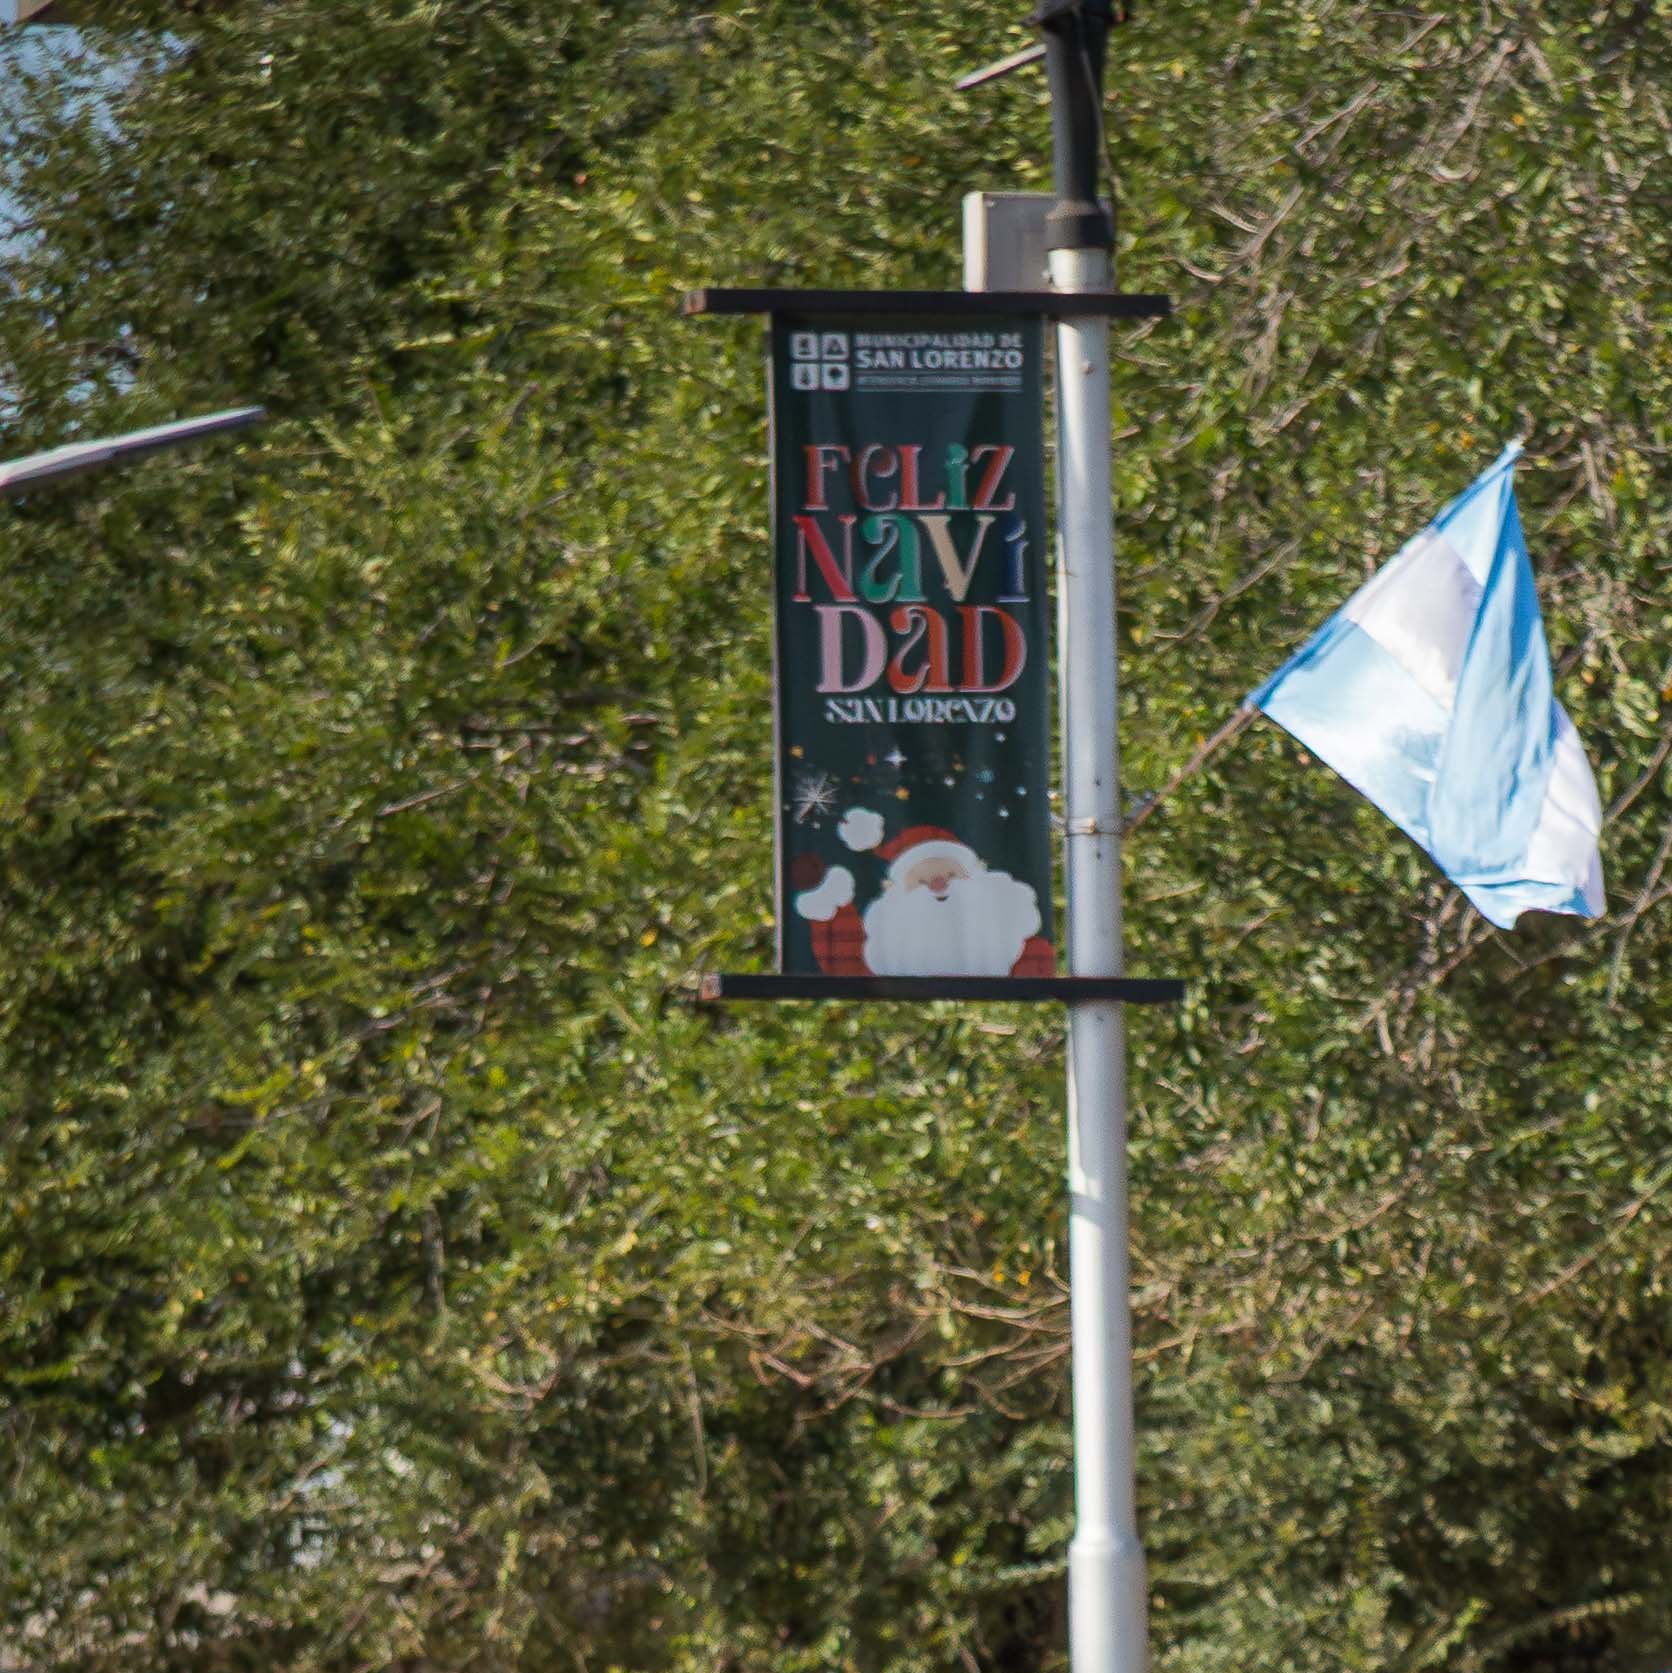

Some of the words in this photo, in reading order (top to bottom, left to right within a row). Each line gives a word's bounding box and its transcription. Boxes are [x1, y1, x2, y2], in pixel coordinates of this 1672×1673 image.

[855, 333, 994, 348] MUNICIPALIDAD
[999, 333, 1023, 348] DE
[855, 349, 906, 369] SAN
[910, 349, 1023, 369] LORENZO
